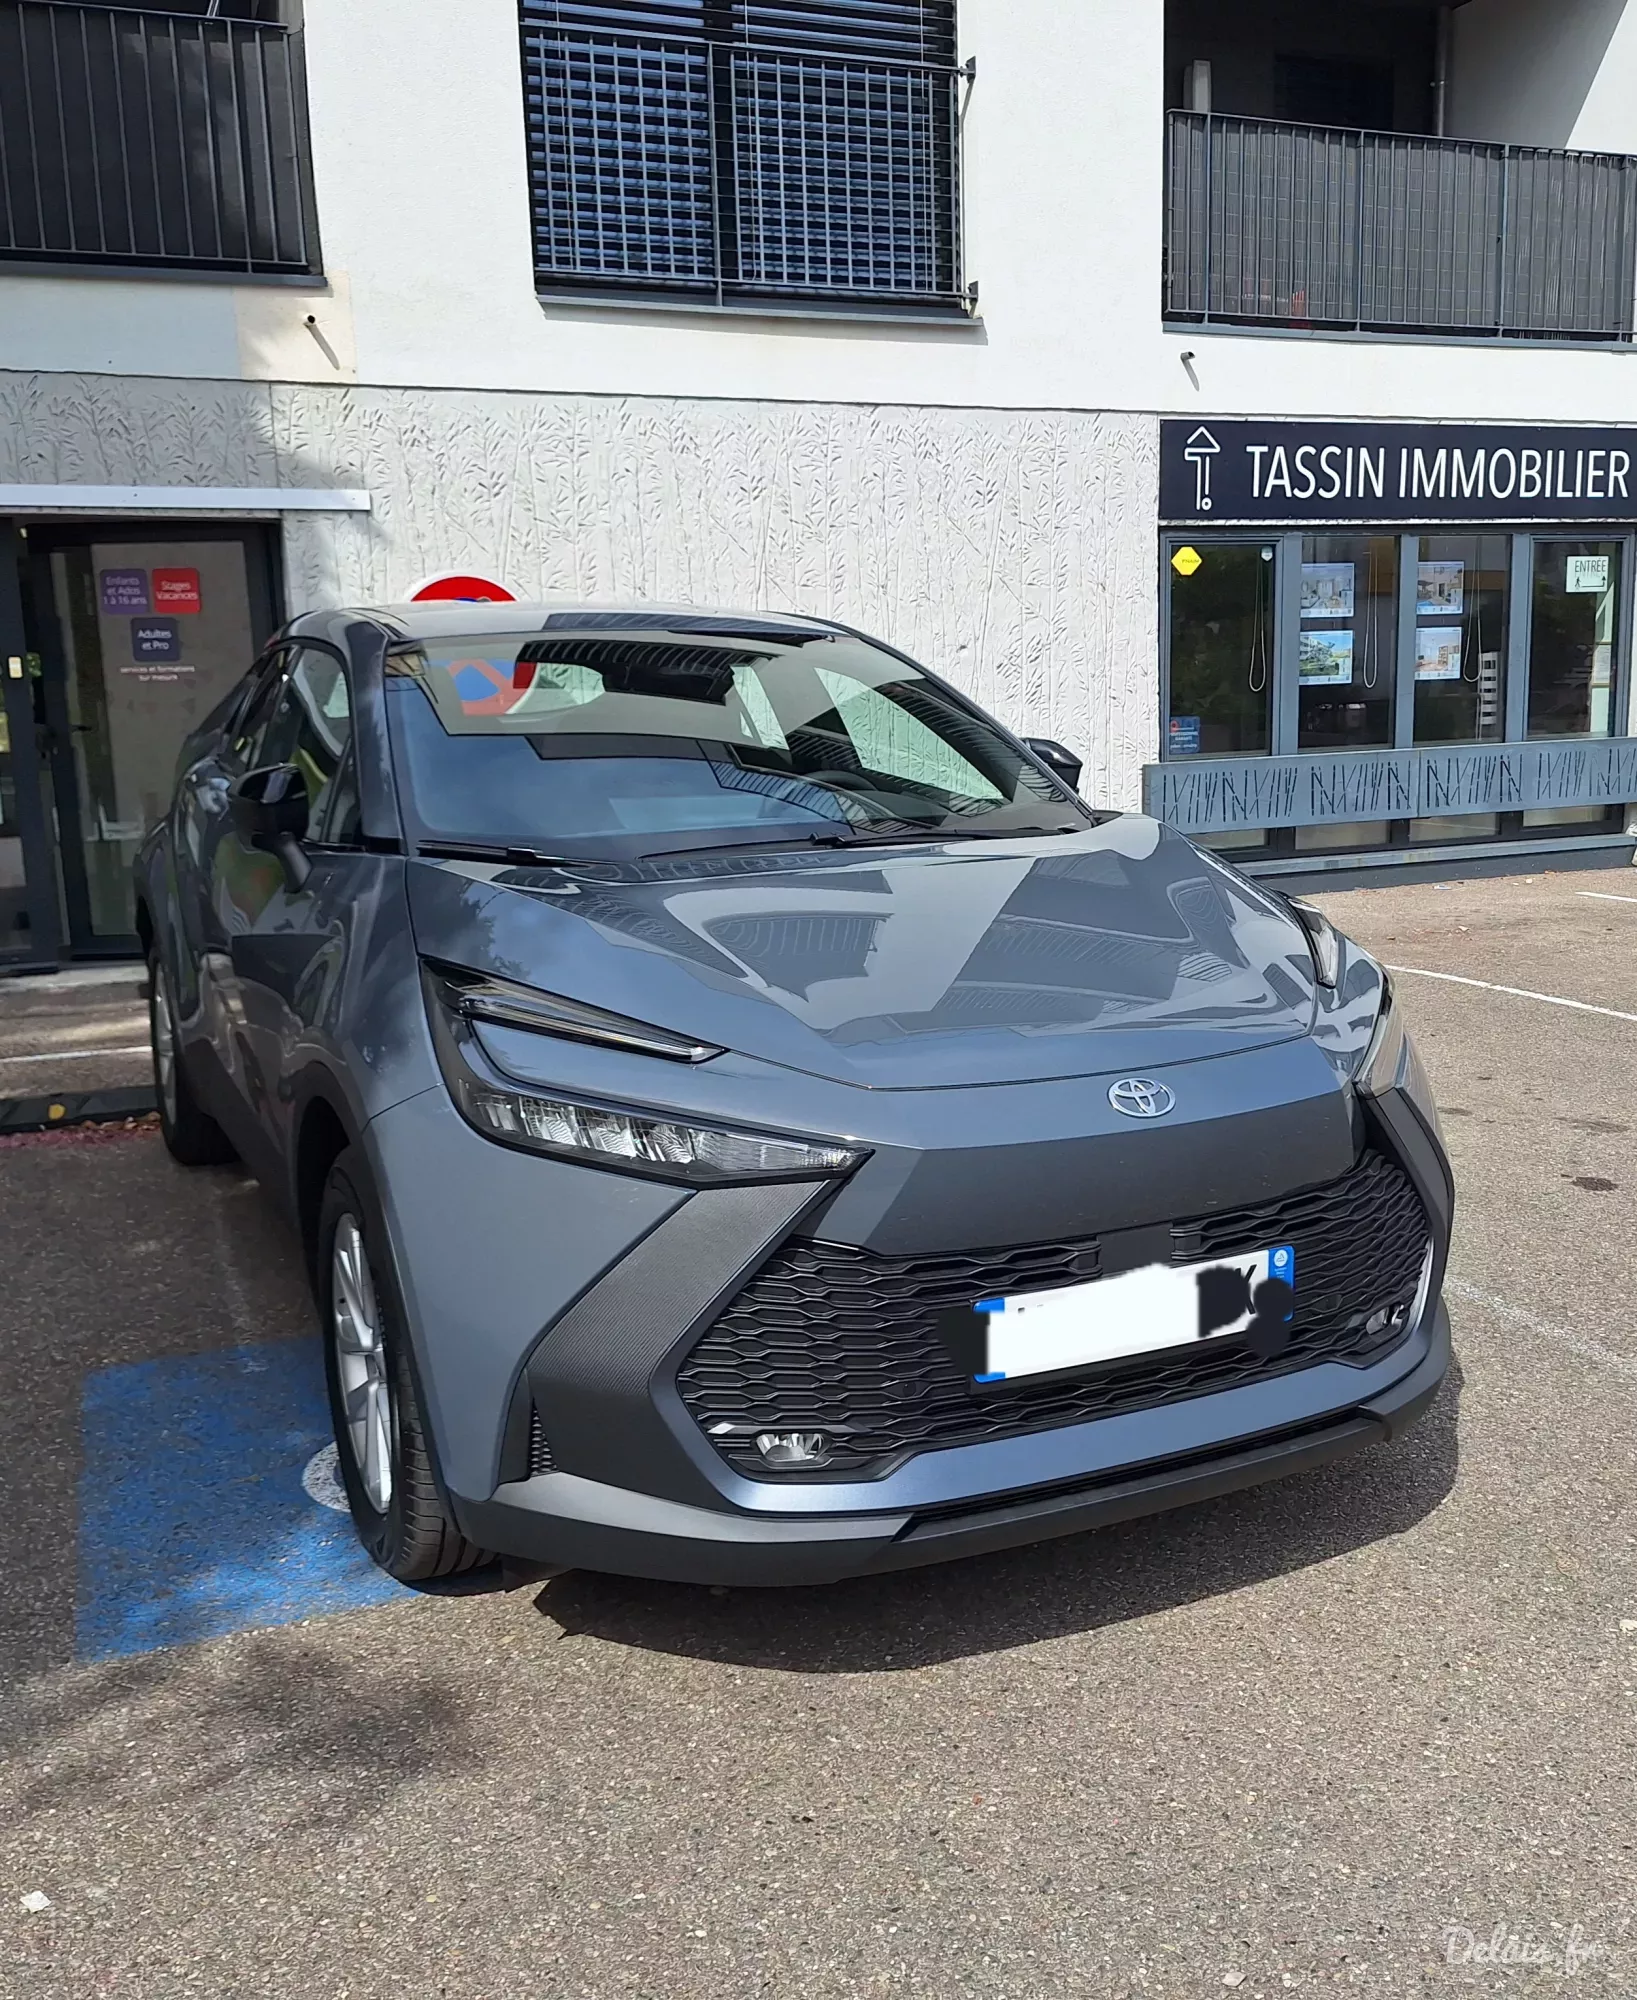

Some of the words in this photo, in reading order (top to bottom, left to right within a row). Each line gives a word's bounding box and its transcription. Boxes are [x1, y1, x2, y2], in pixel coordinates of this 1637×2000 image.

[1246, 445, 1385, 498] TASSIN
[1398, 447, 1630, 499] IMMOBILIER
[1574, 558, 1606, 573] ENTRÉE
[161, 581, 191, 592] Stages
[156, 592, 199, 600] Vacances
[138, 629, 172, 639] Adultes
[142, 641, 151, 650] et
[152, 640, 169, 650] Pro
